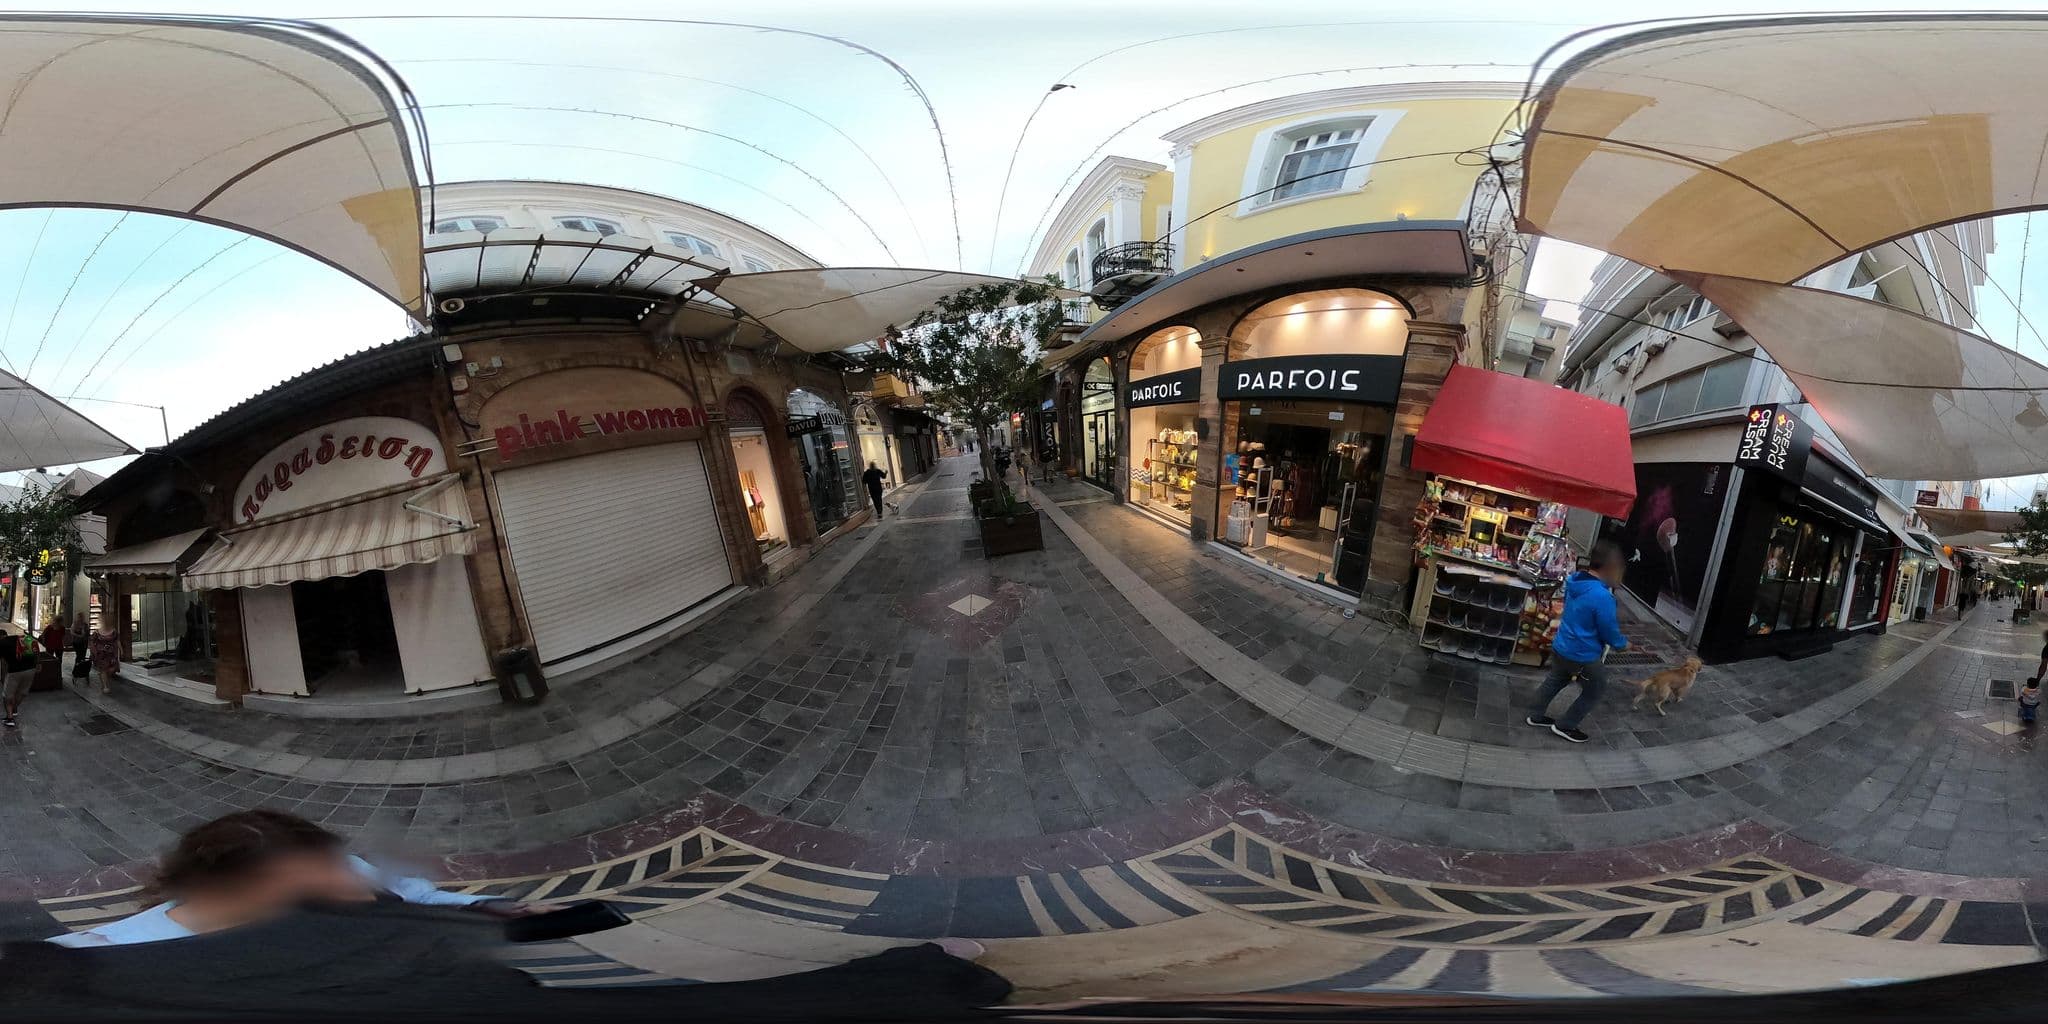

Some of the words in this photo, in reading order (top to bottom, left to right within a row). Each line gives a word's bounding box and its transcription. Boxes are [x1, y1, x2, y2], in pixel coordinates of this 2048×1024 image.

[1132, 381, 1182, 402] PARFOIS
[1237, 368, 1361, 391] PARFOIS
[494, 409, 586, 463] pink
[594, 406, 709, 435] woman
[789, 419, 817, 433] DAVID
[1740, 422, 1758, 460] DUST
[1750, 409, 1772, 460] CREAM
[1767, 424, 1784, 466] DUST
[1775, 419, 1795, 470] CREAM
[241, 433, 433, 522] παραδειση
